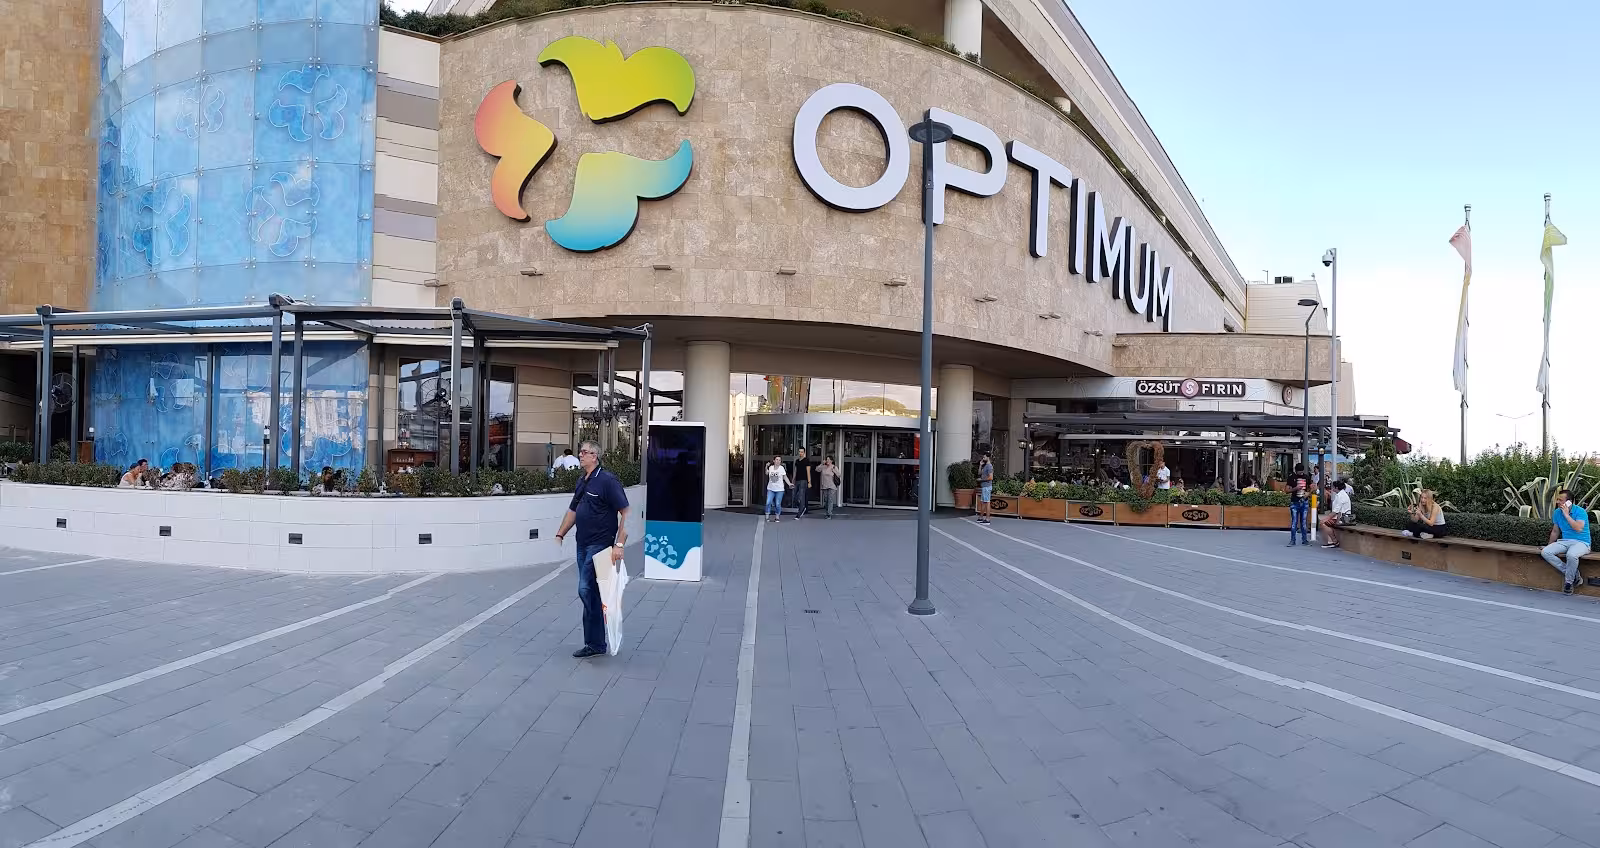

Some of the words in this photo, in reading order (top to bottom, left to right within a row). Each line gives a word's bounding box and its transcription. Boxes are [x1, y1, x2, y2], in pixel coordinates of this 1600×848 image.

[793, 83, 1174, 333] OPTIMUM
[1137, 380, 1180, 394] ÖZSÜT
[1201, 384, 1243, 395] FIRIN
